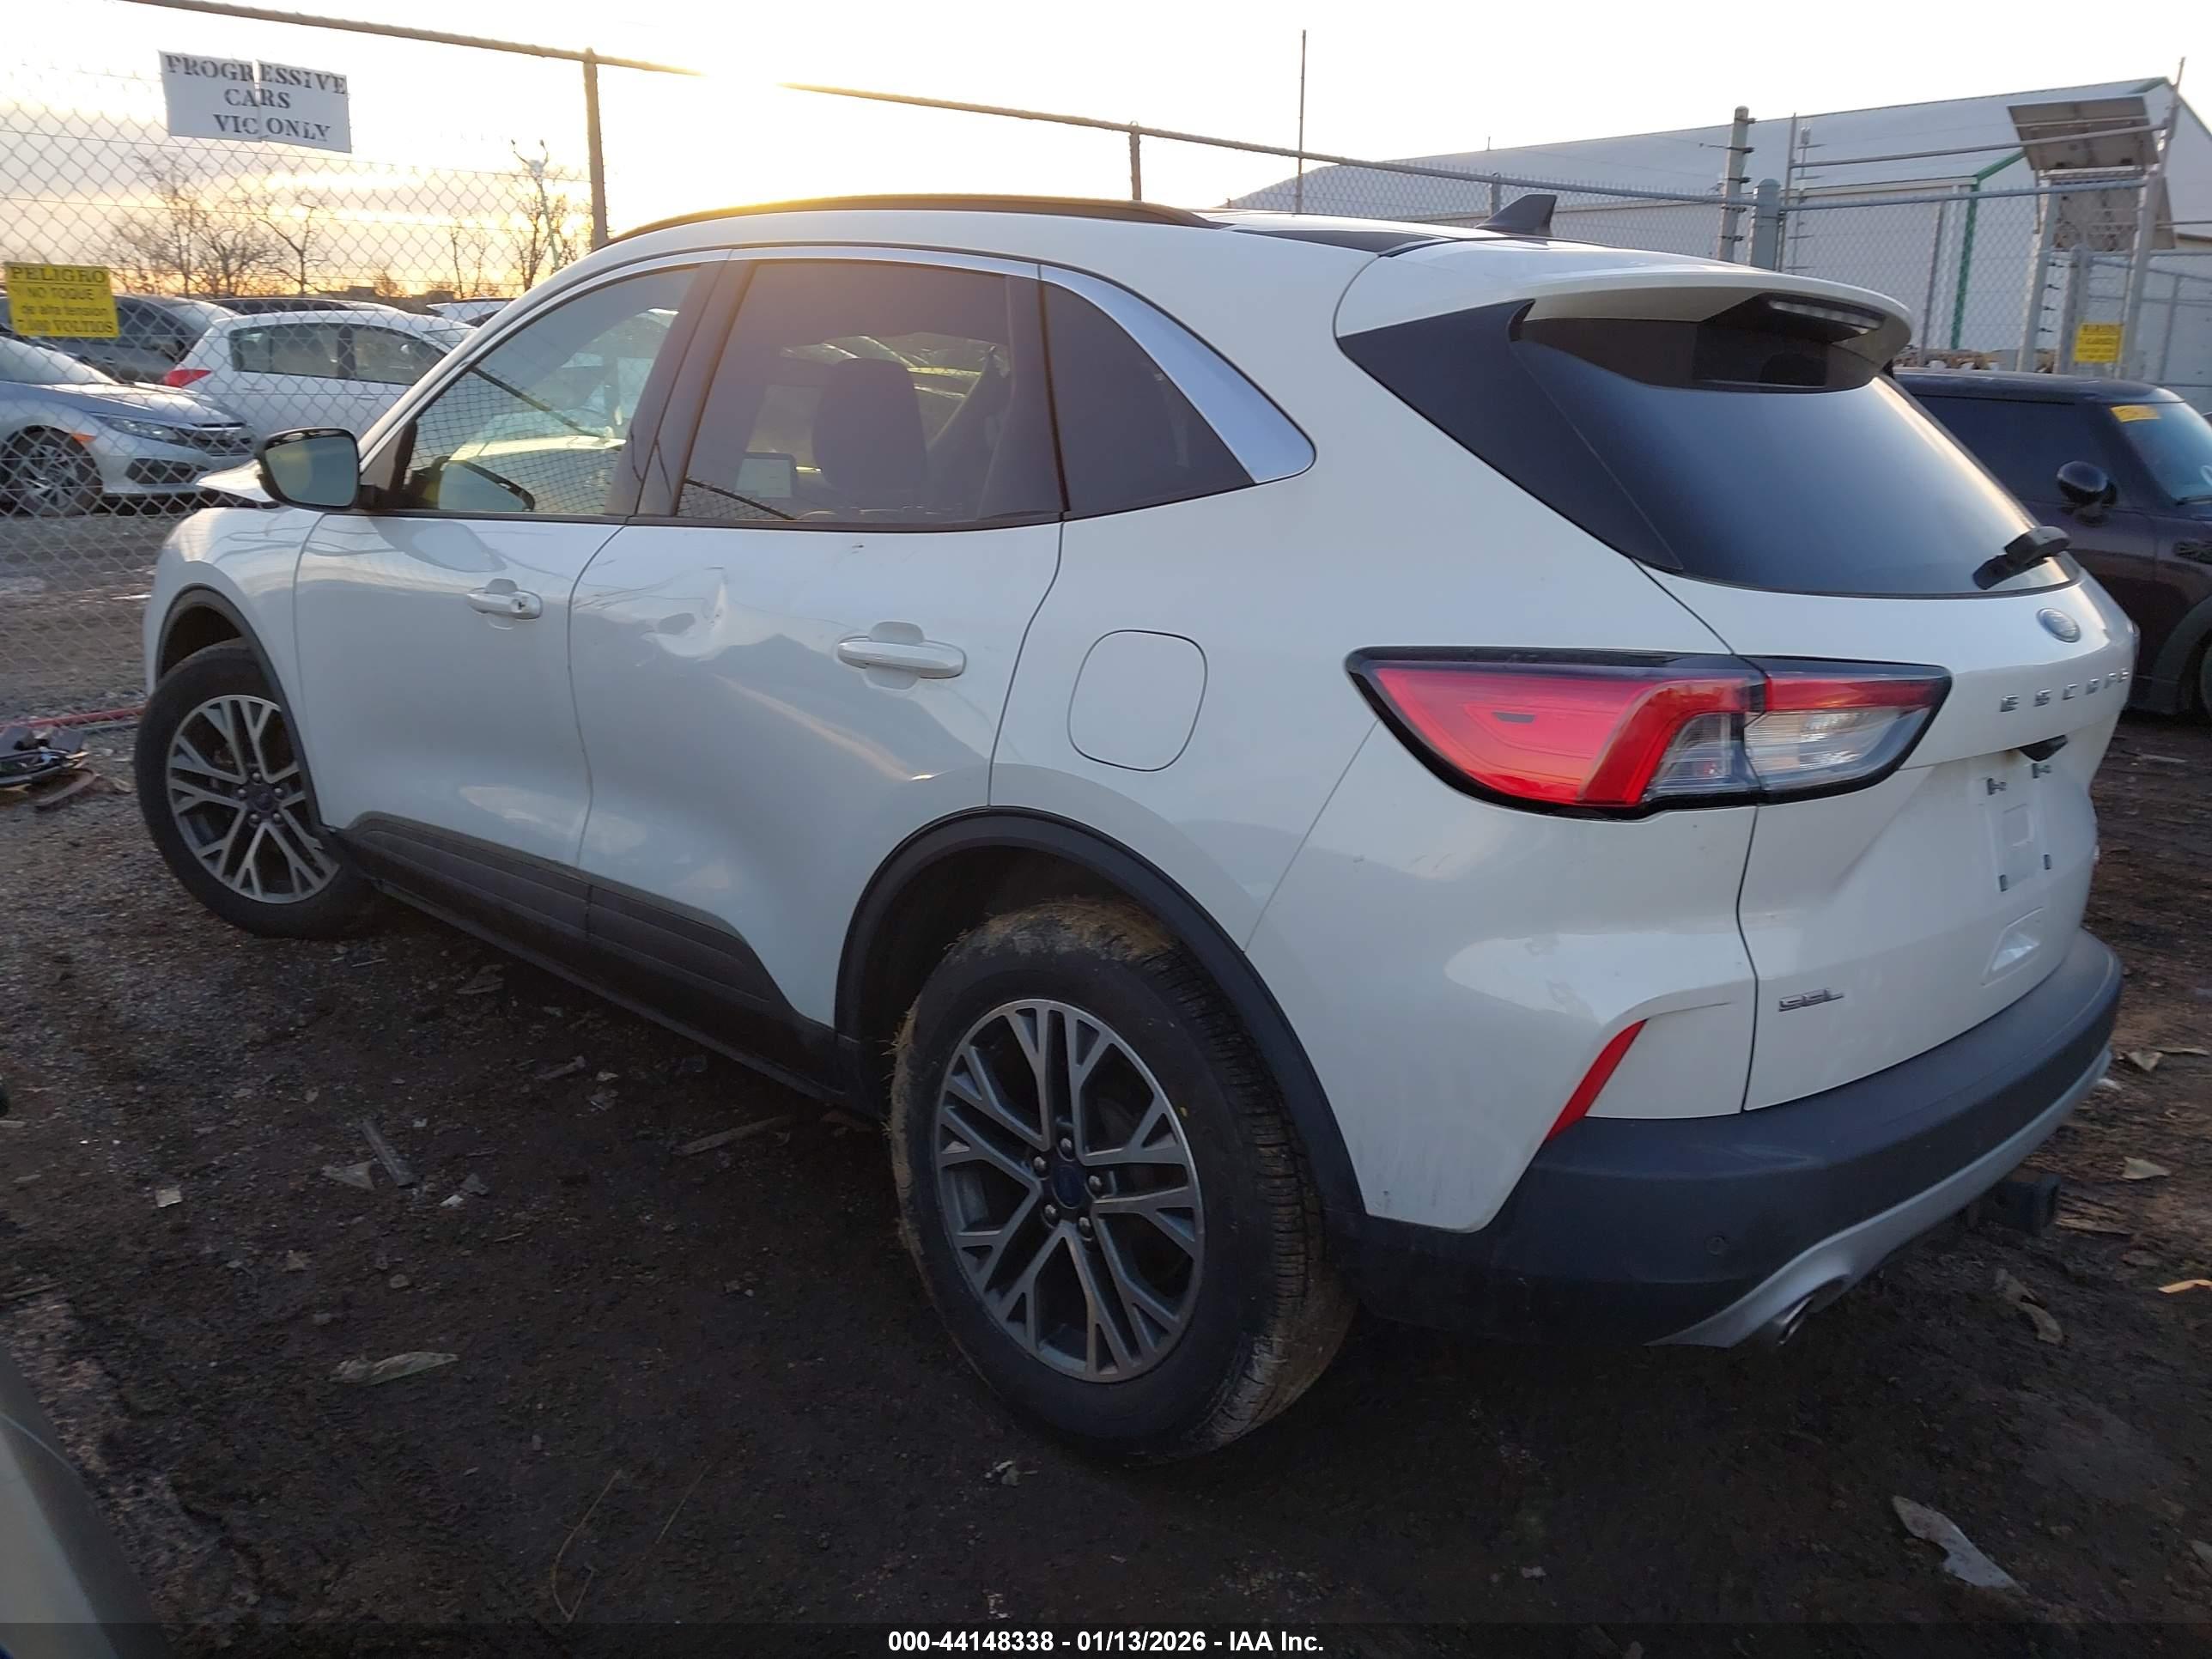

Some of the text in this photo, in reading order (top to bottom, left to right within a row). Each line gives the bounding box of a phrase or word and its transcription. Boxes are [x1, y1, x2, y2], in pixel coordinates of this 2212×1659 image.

[166, 54, 348, 94] PROGRESSIVE
[223, 88, 291, 109] CARS
[213, 113, 331, 142] VIC ONLY
[10, 266, 107, 284] PELIGRO
